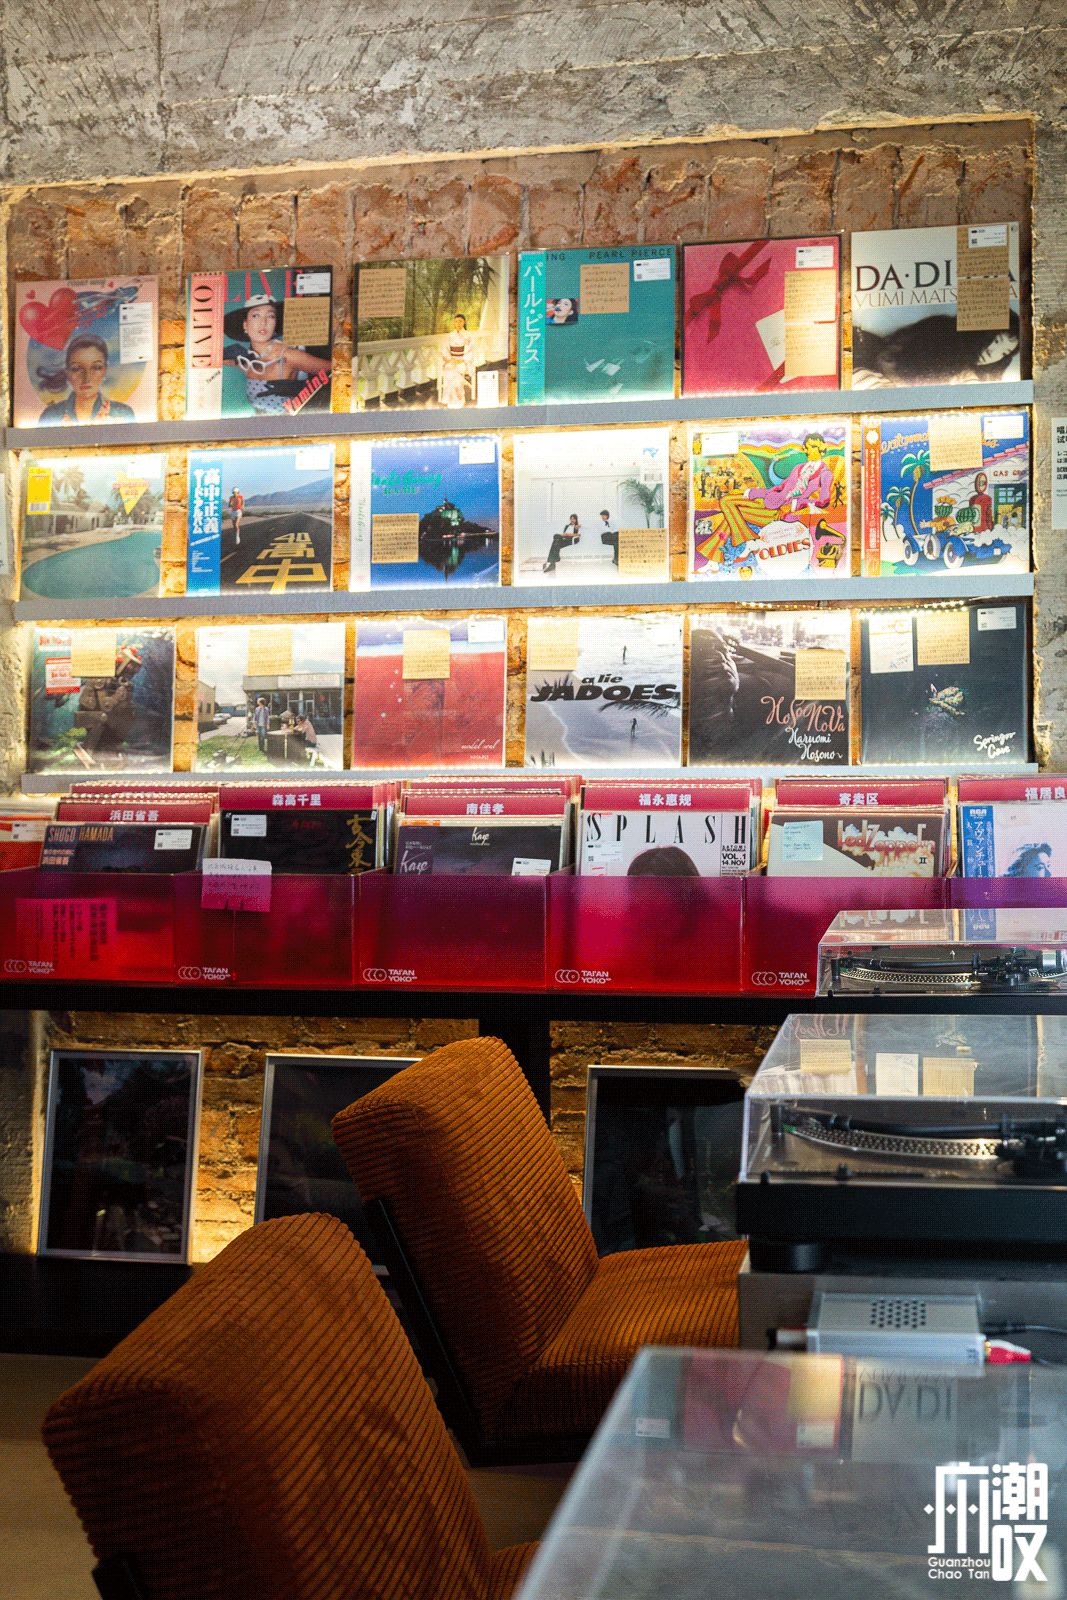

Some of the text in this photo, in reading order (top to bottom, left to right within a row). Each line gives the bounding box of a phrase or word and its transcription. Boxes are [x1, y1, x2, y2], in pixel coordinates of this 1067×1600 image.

[588, 250, 627, 260] PEARL
[631, 248, 672, 257] PIERCE
[854, 291, 904, 308] YUMI
[283, 369, 329, 412] Yuming
[993, 469, 1009, 477] GAS
[759, 537, 811, 560] OLDIES
[597, 673, 623, 684] lie
[530, 684, 677, 703] JADOES
[785, 727, 832, 746] Haruomi
[800, 743, 837, 762] Hosono
[272, 793, 322, 807] 森高千里
[839, 792, 879, 805] 寄卖区
[465, 803, 505, 815] 南佳孝
[48, 826, 115, 843] SHOGO HAMADA
[587, 814, 747, 844] SPLASH
